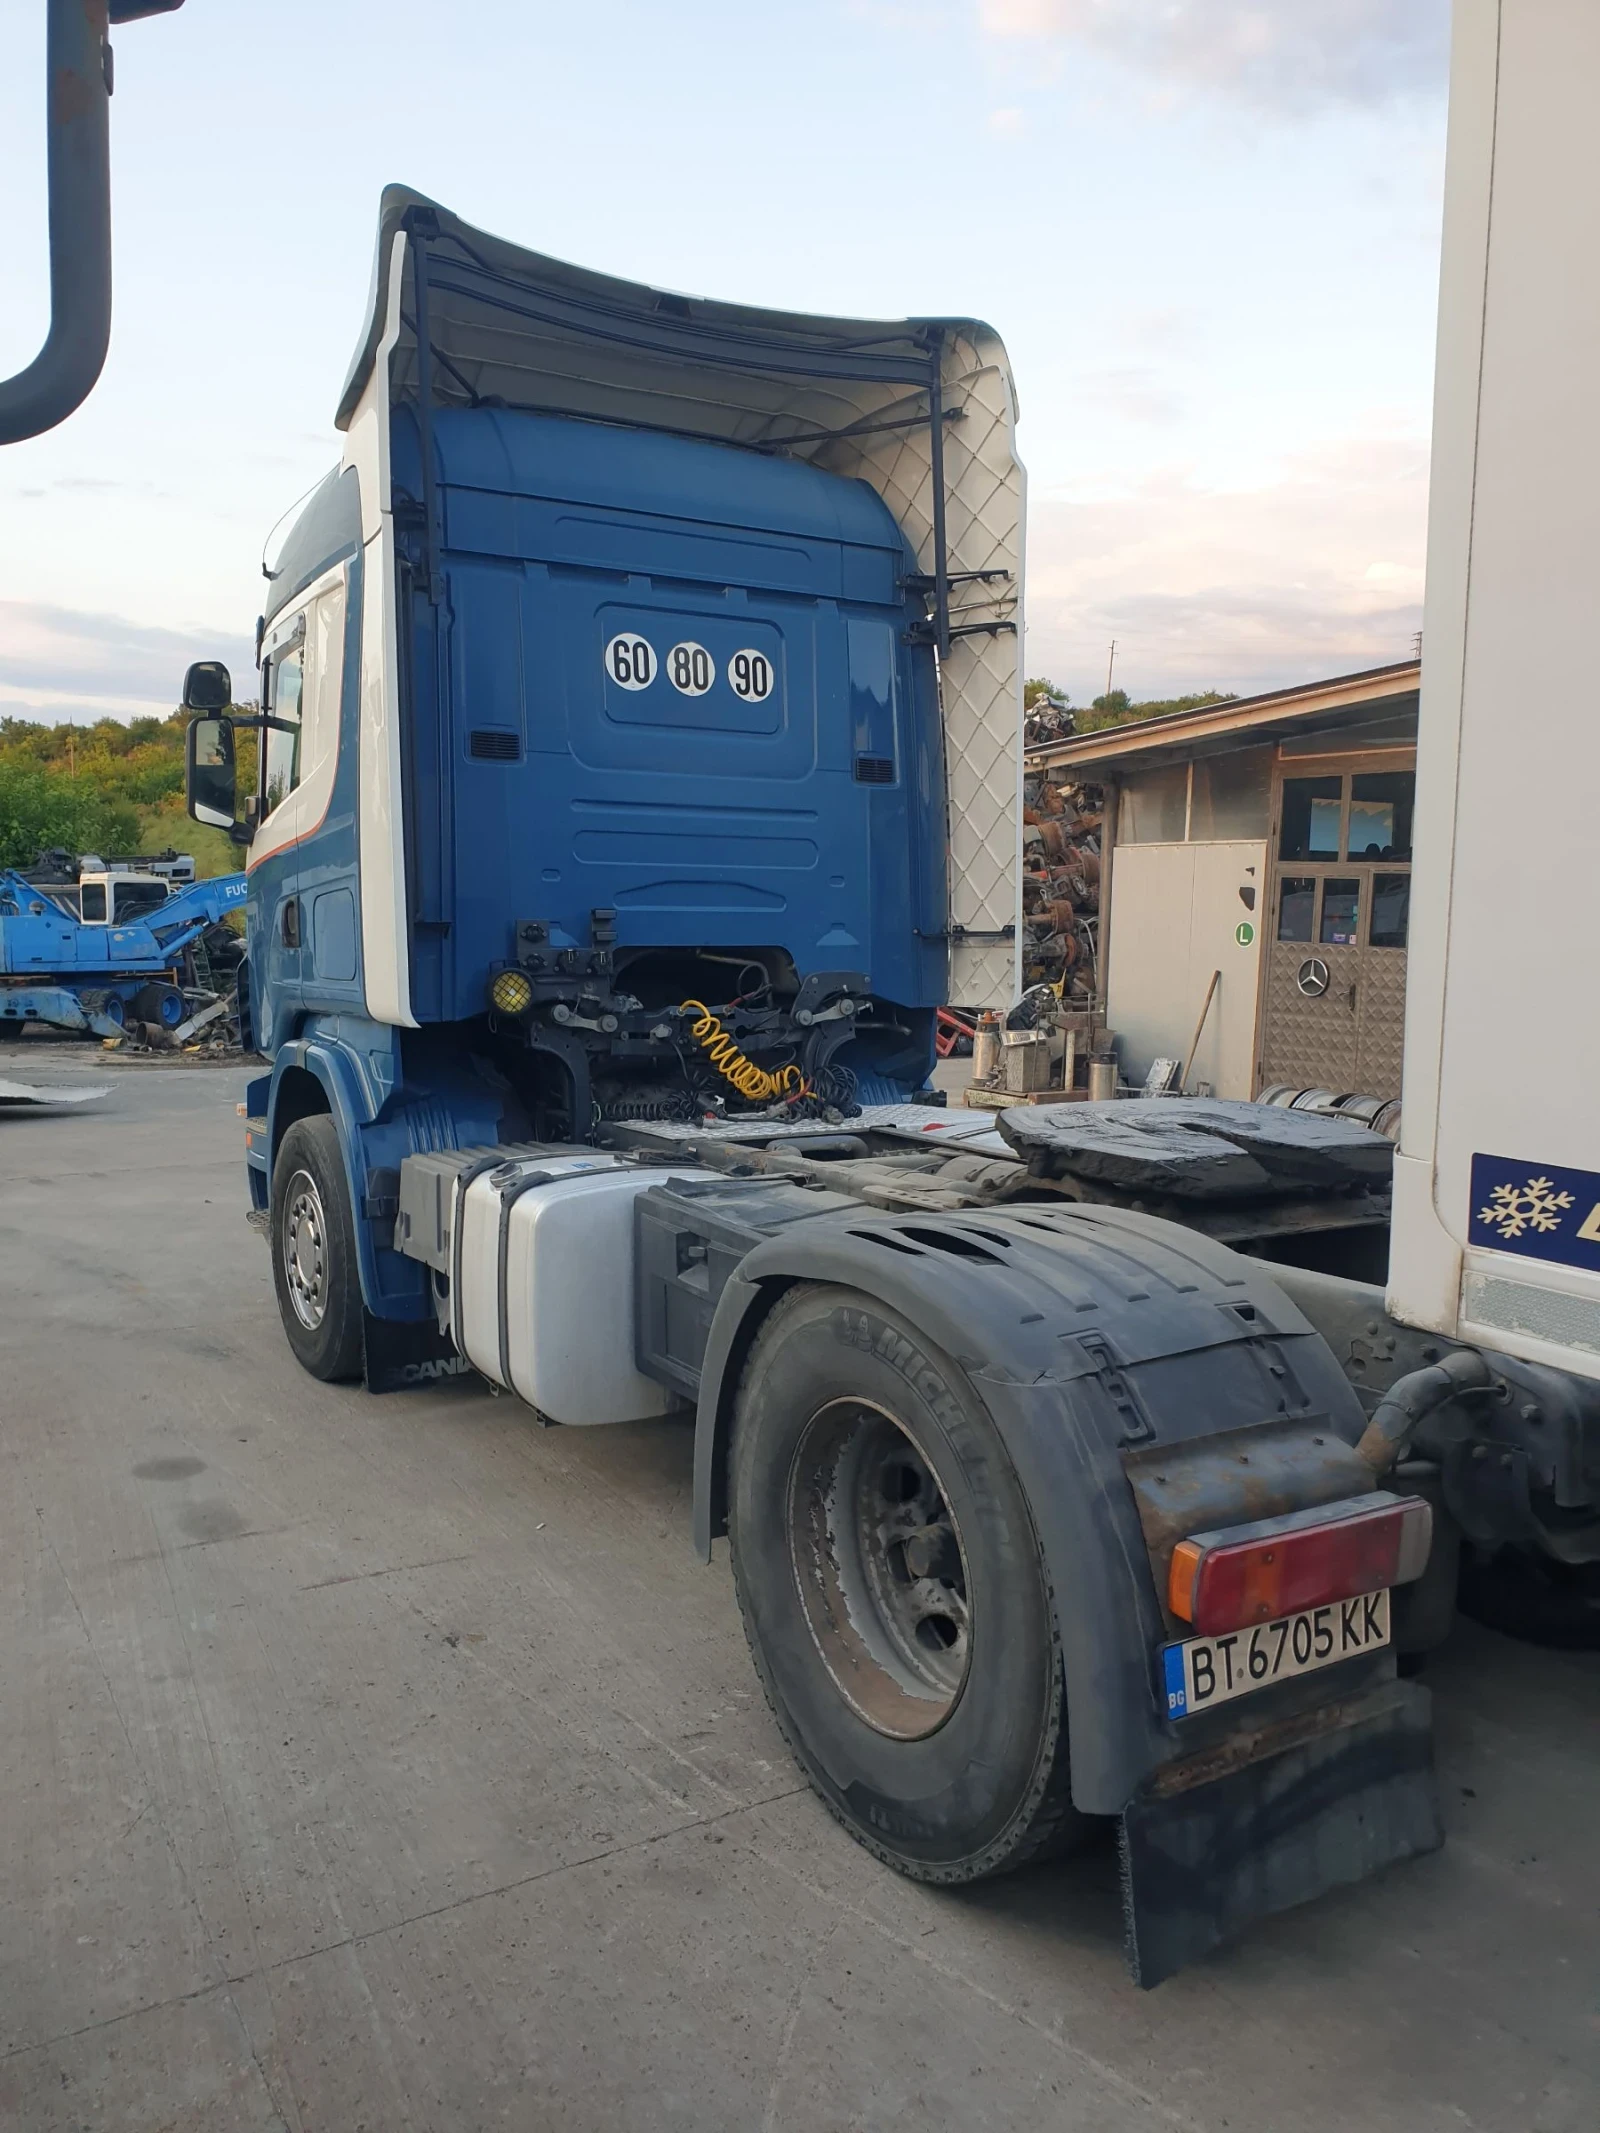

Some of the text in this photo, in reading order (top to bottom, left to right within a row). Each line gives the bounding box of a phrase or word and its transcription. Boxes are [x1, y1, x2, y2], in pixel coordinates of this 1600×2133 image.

[613, 640, 651, 684] 60
[674, 647, 708, 690] 80
[734, 654, 767, 697] 90
[1239, 926, 1248, 942] L
[387, 1356, 469, 1385] CANI
[1168, 1690, 1185, 1710] BG
